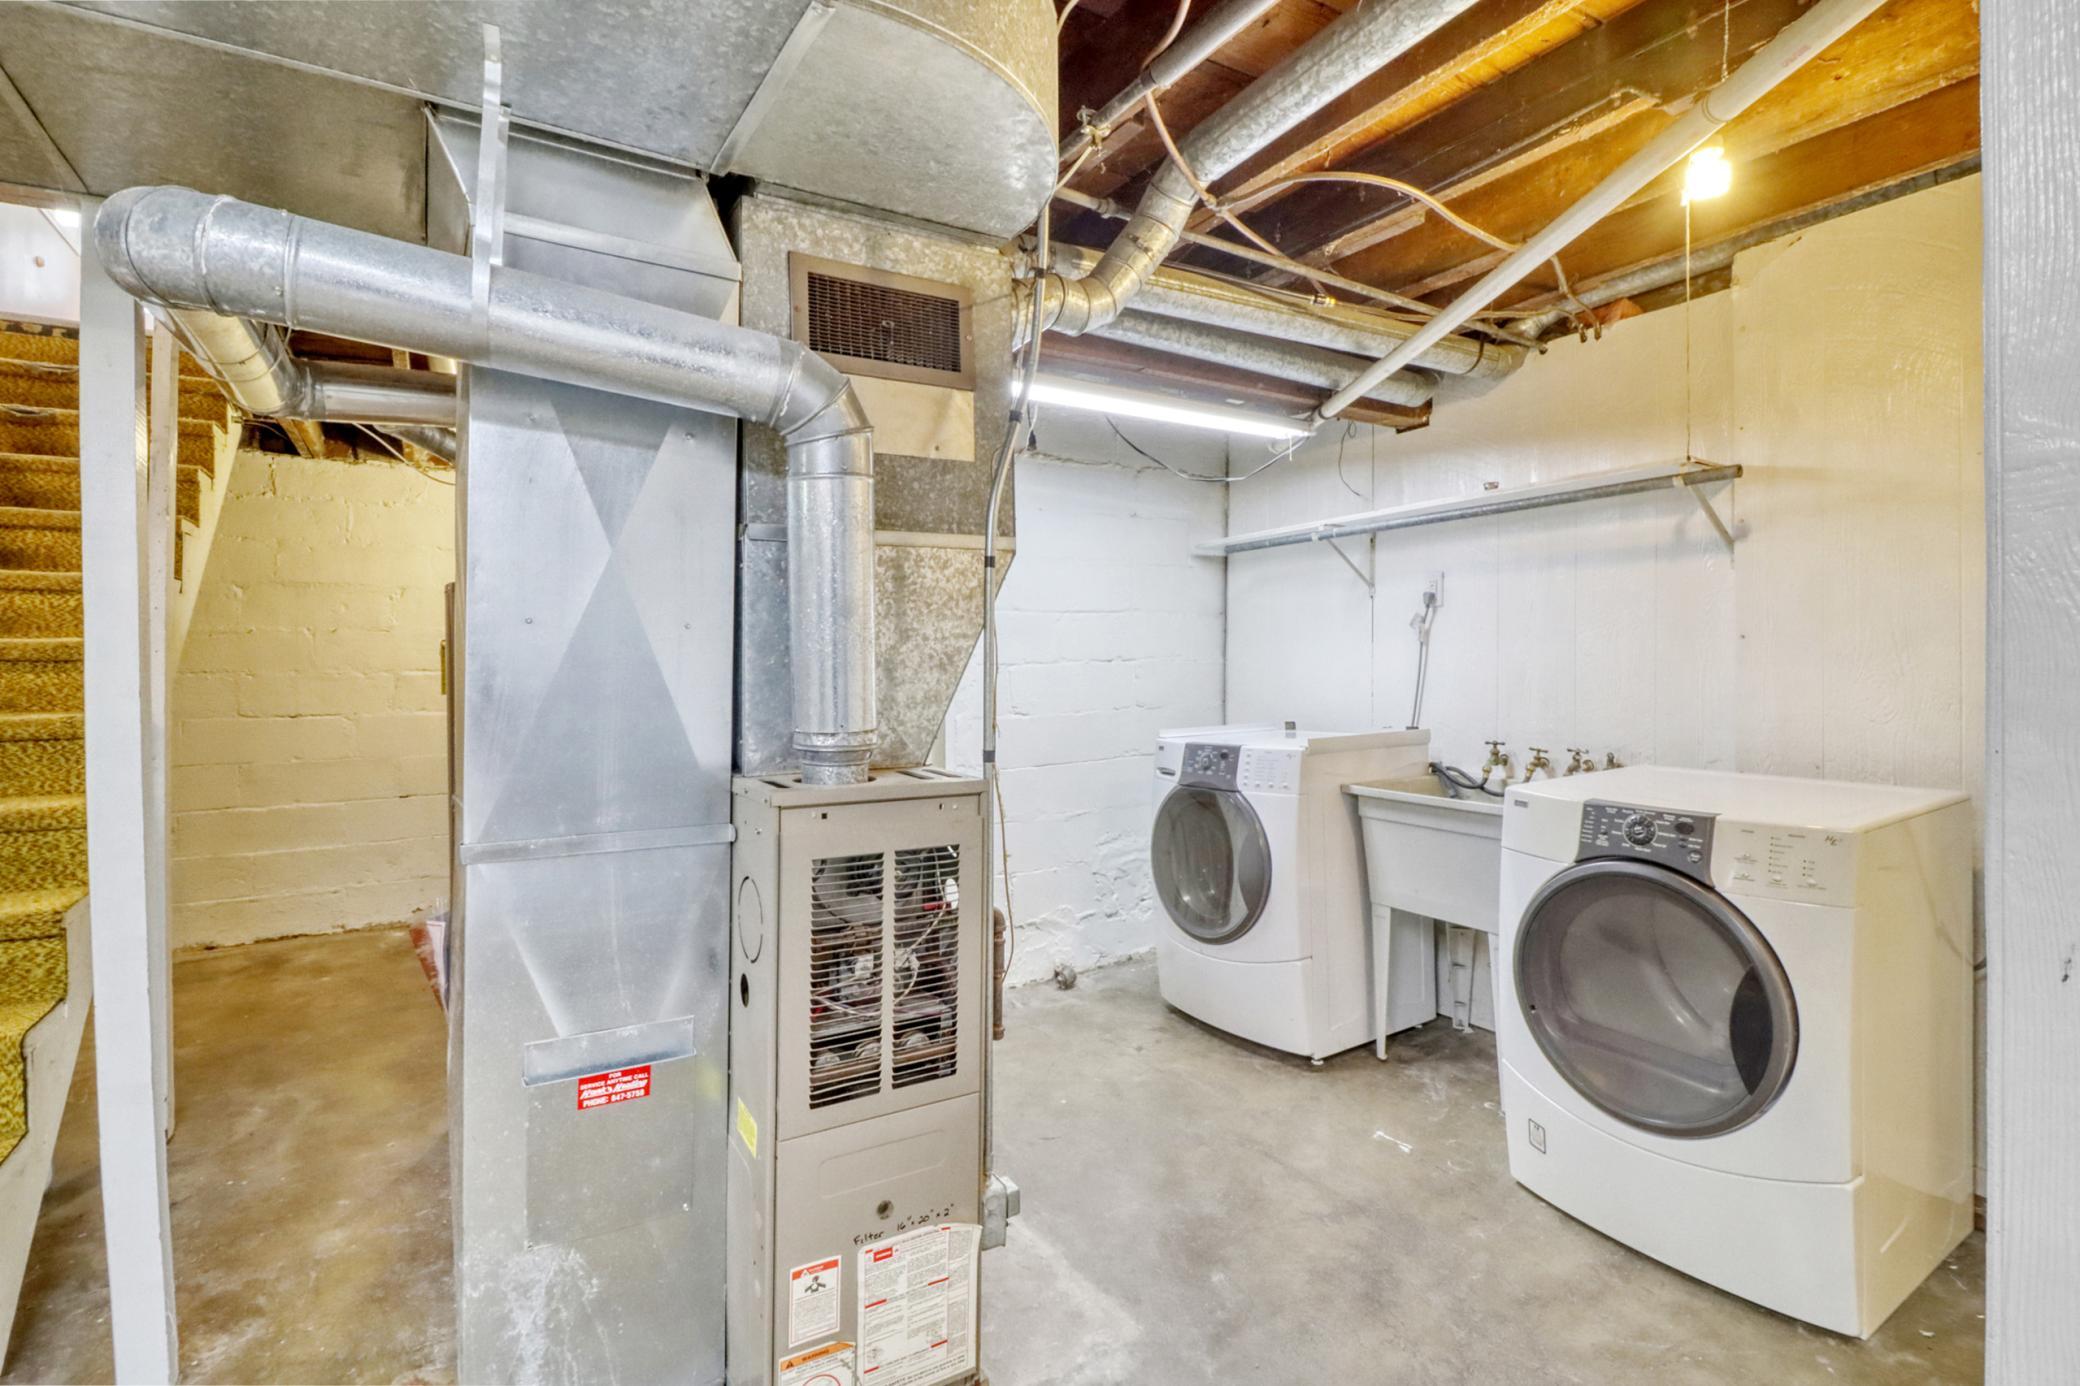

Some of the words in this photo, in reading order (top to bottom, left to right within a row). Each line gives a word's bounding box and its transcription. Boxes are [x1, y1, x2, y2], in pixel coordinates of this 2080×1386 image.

[580, 1081, 606, 1090] SERVICE
[607, 1075, 632, 1085] ANYTIME
[853, 1231, 884, 1245] Filter
